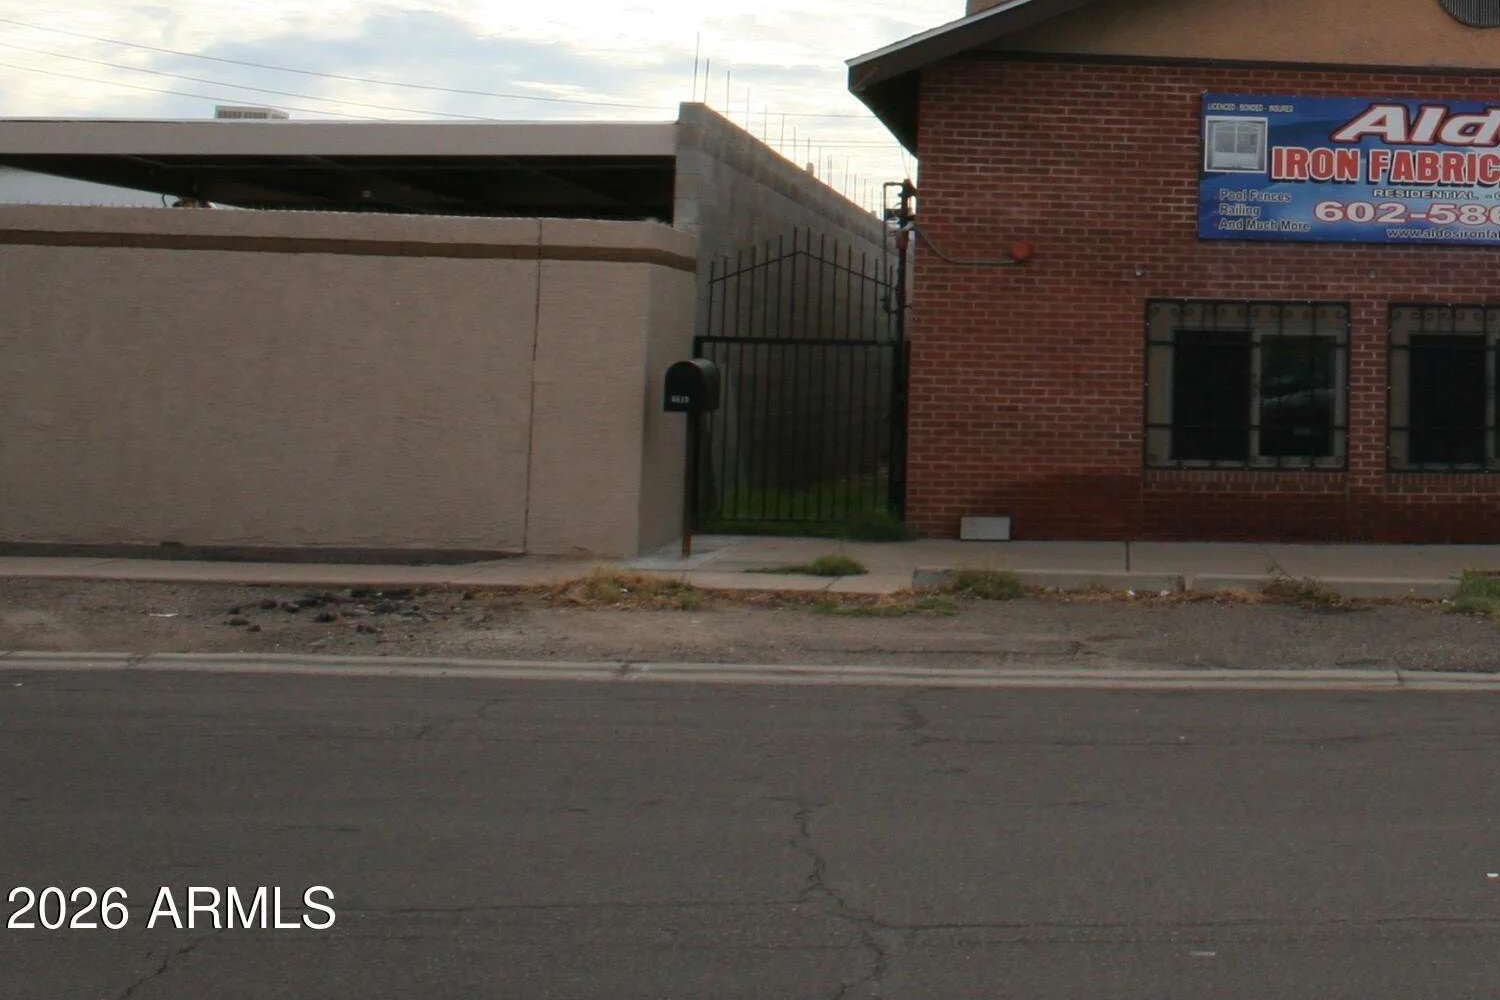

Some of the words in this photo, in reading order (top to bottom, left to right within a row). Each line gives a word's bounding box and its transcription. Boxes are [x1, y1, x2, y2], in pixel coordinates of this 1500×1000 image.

[1271, 146, 1360, 181] IRON
[1220, 188, 1247, 200] Pool
[1249, 189, 1291, 202] Fences
[1373, 189, 1474, 200] RESIDENTIAL
[1219, 203, 1260, 217] Railing
[1218, 218, 1244, 230] And
[1246, 219, 1278, 231] Much
[1280, 220, 1311, 232] More
